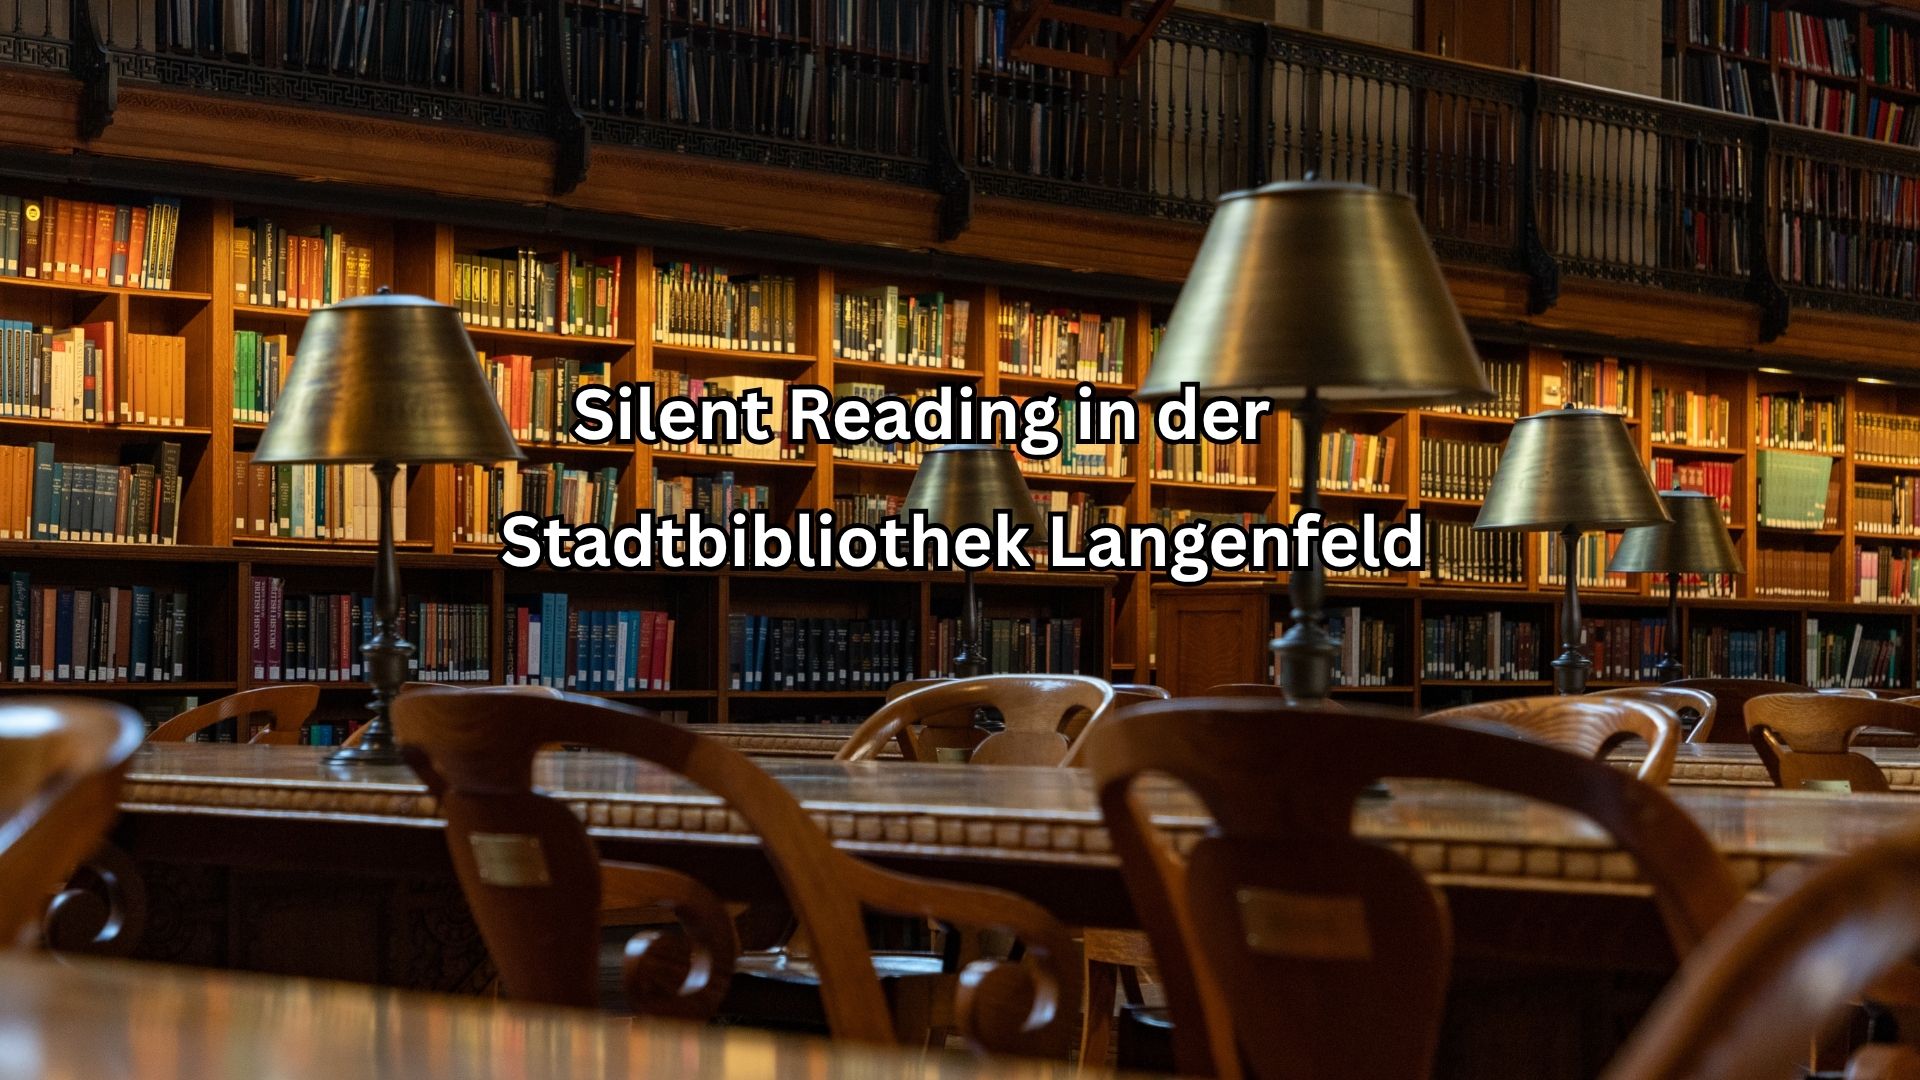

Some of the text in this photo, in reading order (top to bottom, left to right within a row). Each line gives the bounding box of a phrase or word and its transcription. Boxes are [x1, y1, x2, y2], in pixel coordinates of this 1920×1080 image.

[138, 479, 146, 523] HISTORY
[163, 463, 172, 504] PEOPLE
[269, 615, 277, 650] HISTORY
